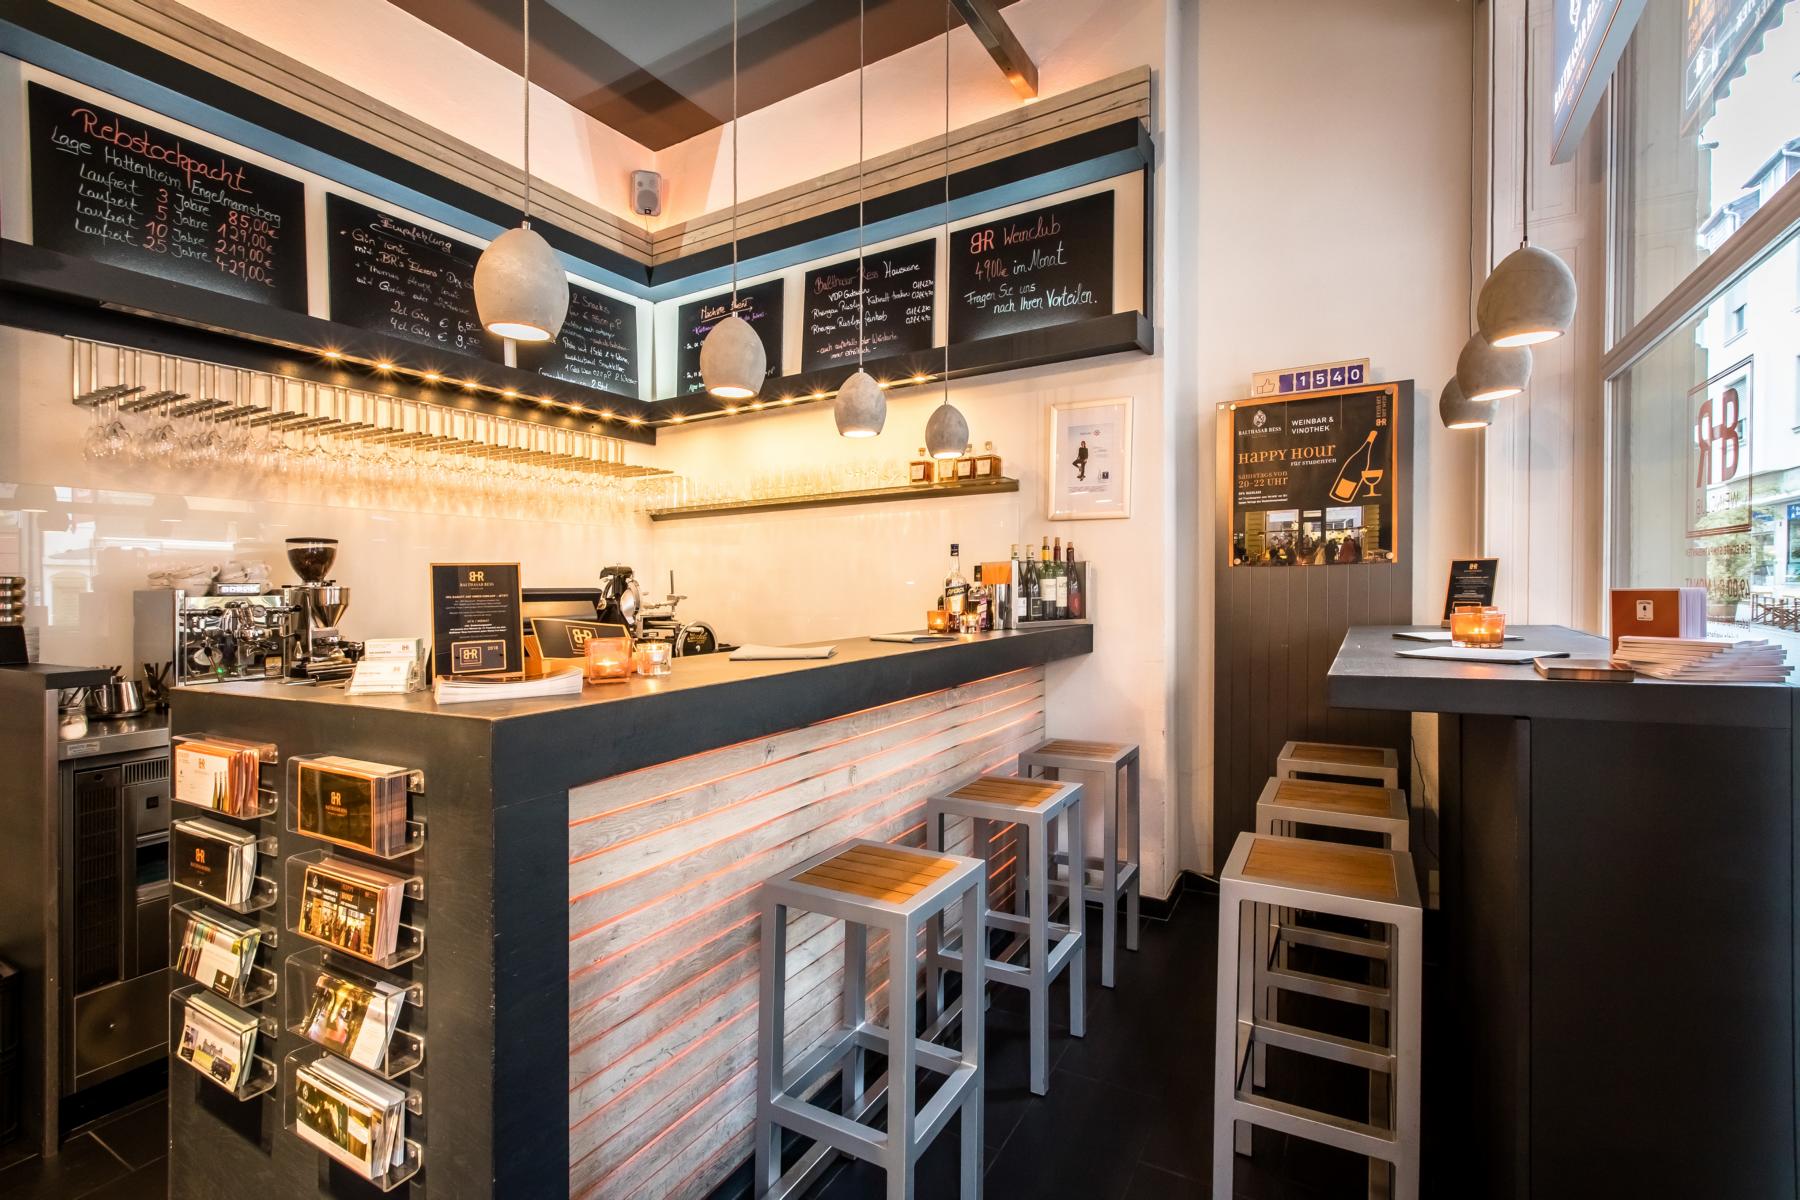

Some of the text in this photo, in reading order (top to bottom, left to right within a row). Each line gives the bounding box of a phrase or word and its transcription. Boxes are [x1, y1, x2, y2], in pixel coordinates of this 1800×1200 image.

[51, 125, 93, 155] Lage
[104, 146, 183, 191] Hattenheim
[156, 188, 169, 204] 3
[174, 193, 211, 217] Jahre
[155, 205, 168, 221] 5
[172, 210, 209, 231] Jahre
[1003, 213, 1061, 246] Weinclub
[145, 221, 169, 239] 10
[172, 228, 206, 245] Jahre
[352, 228, 376, 246] Gin
[142, 236, 168, 254] 25
[170, 243, 212, 263] Jahre
[1013, 260, 1027, 275] im
[1027, 240, 1068, 272] Monat
[963, 291, 996, 309] Fragen
[1019, 282, 1036, 295] uns
[993, 300, 1016, 314] nach
[1020, 297, 1044, 312] Ihren
[1300, 369, 1360, 387] 1540
[1238, 428, 1268, 436] BALTHASAR
[1291, 417, 1327, 426] WEINBAR
[1291, 425, 1330, 435] VINOTHEK
